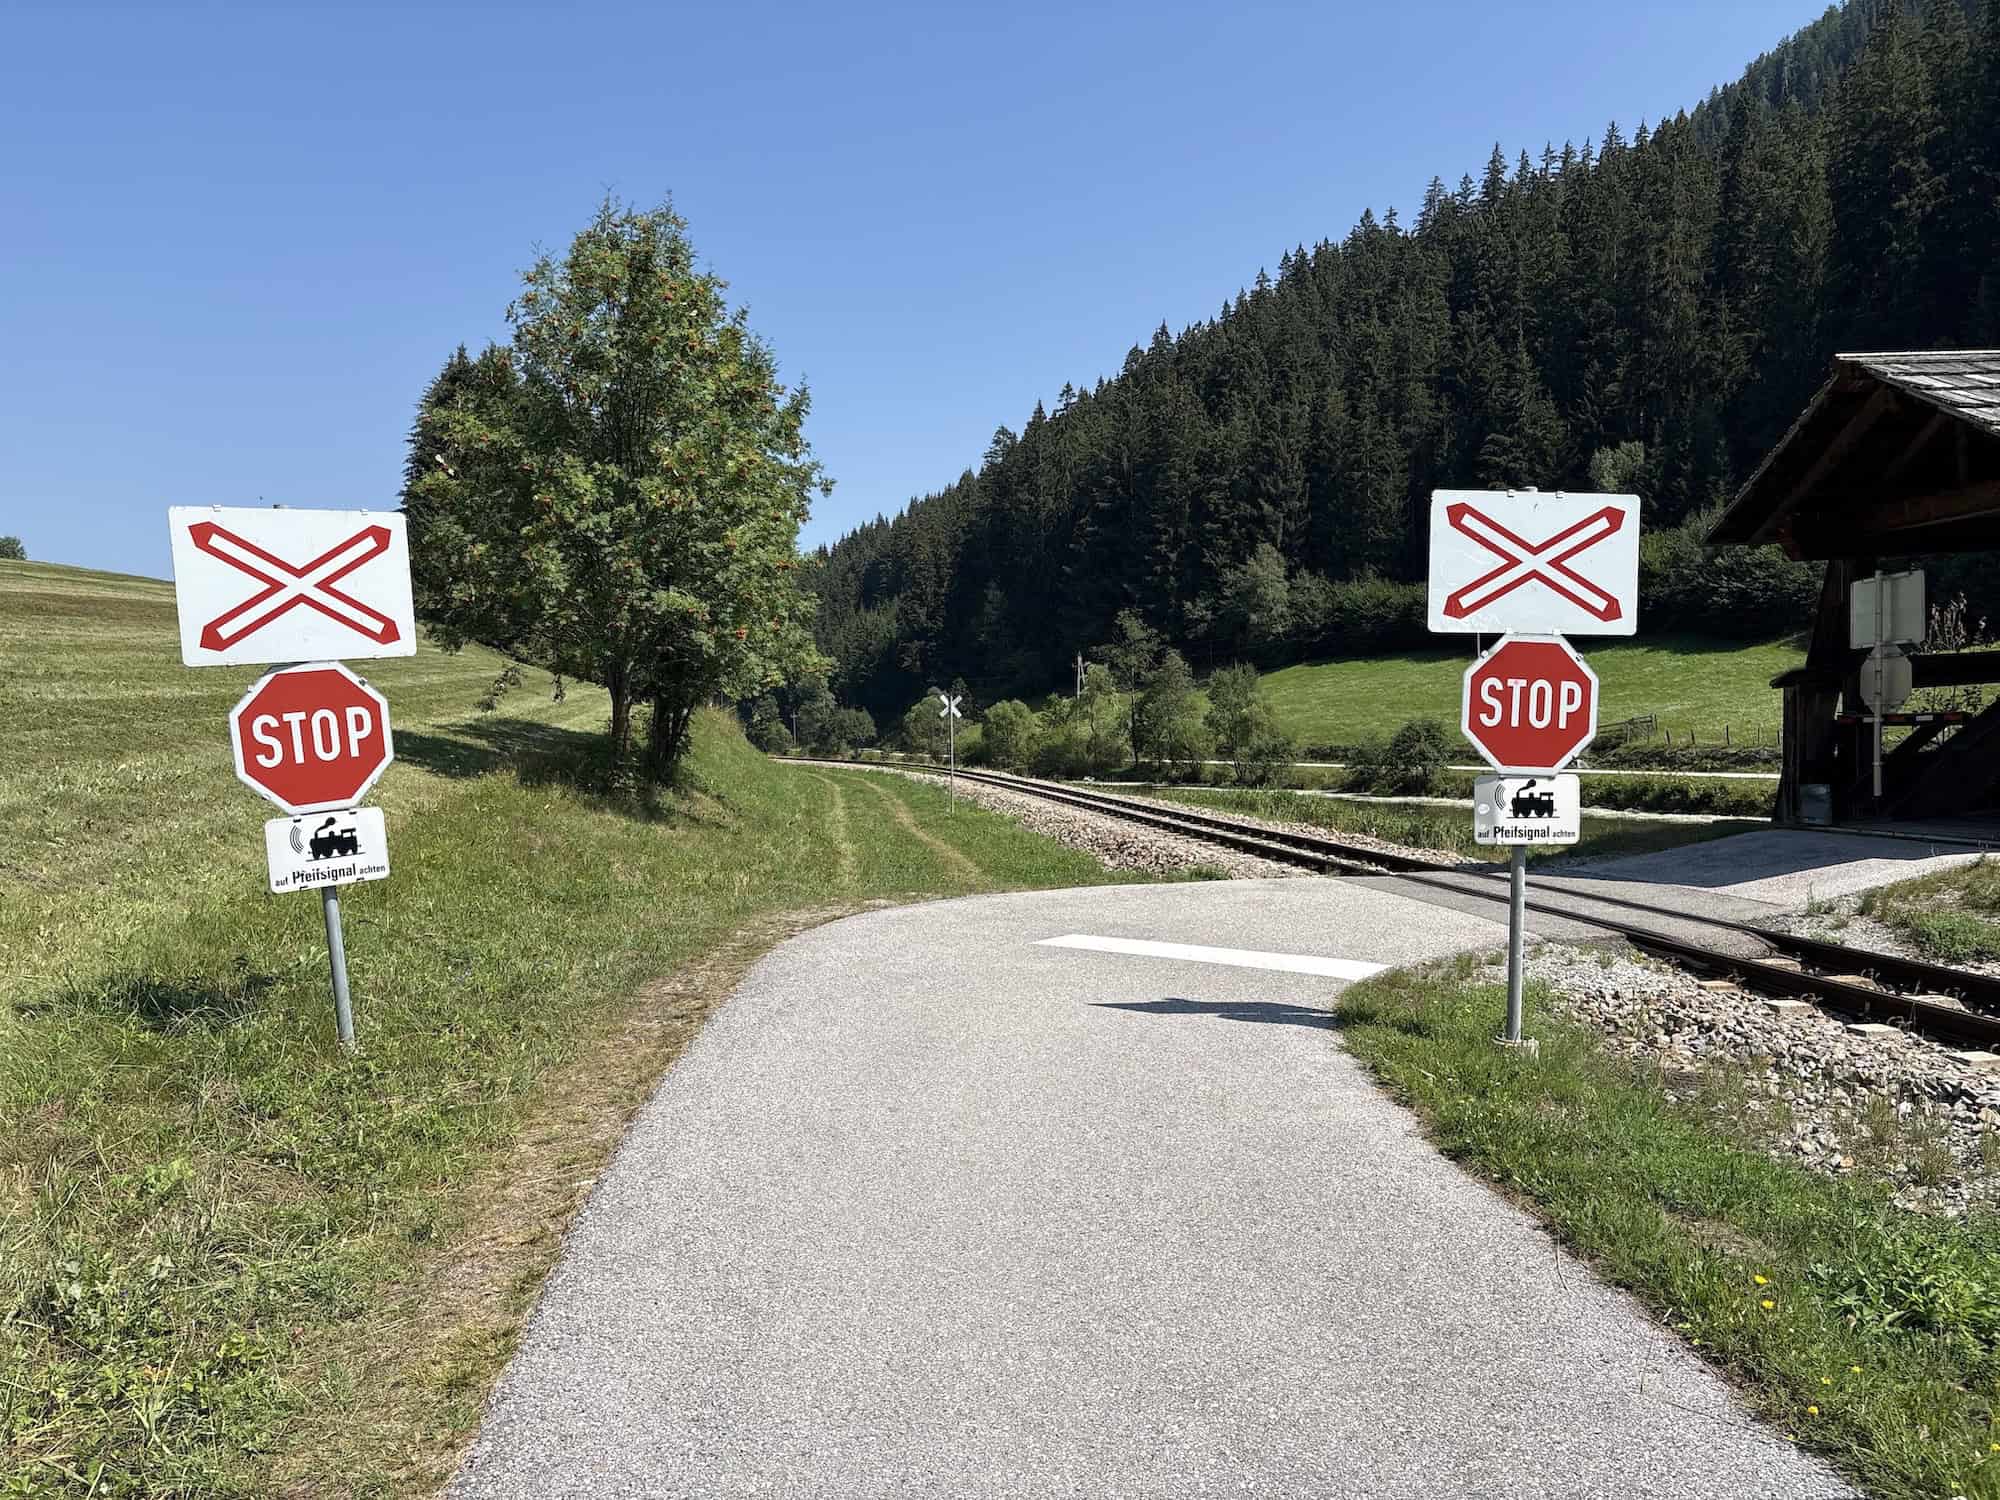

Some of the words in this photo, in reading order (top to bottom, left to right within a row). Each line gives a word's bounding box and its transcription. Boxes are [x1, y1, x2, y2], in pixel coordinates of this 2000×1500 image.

[1479, 676, 1582, 729] STOP
[252, 706, 373, 768] STOP
[1477, 829, 1490, 838] auf
[1493, 825, 1550, 841] Pfeifsignal
[1552, 829, 1576, 838] achten
[275, 876, 289, 887] auf
[292, 863, 357, 884] Pfeifsignal
[359, 864, 386, 875] achten
